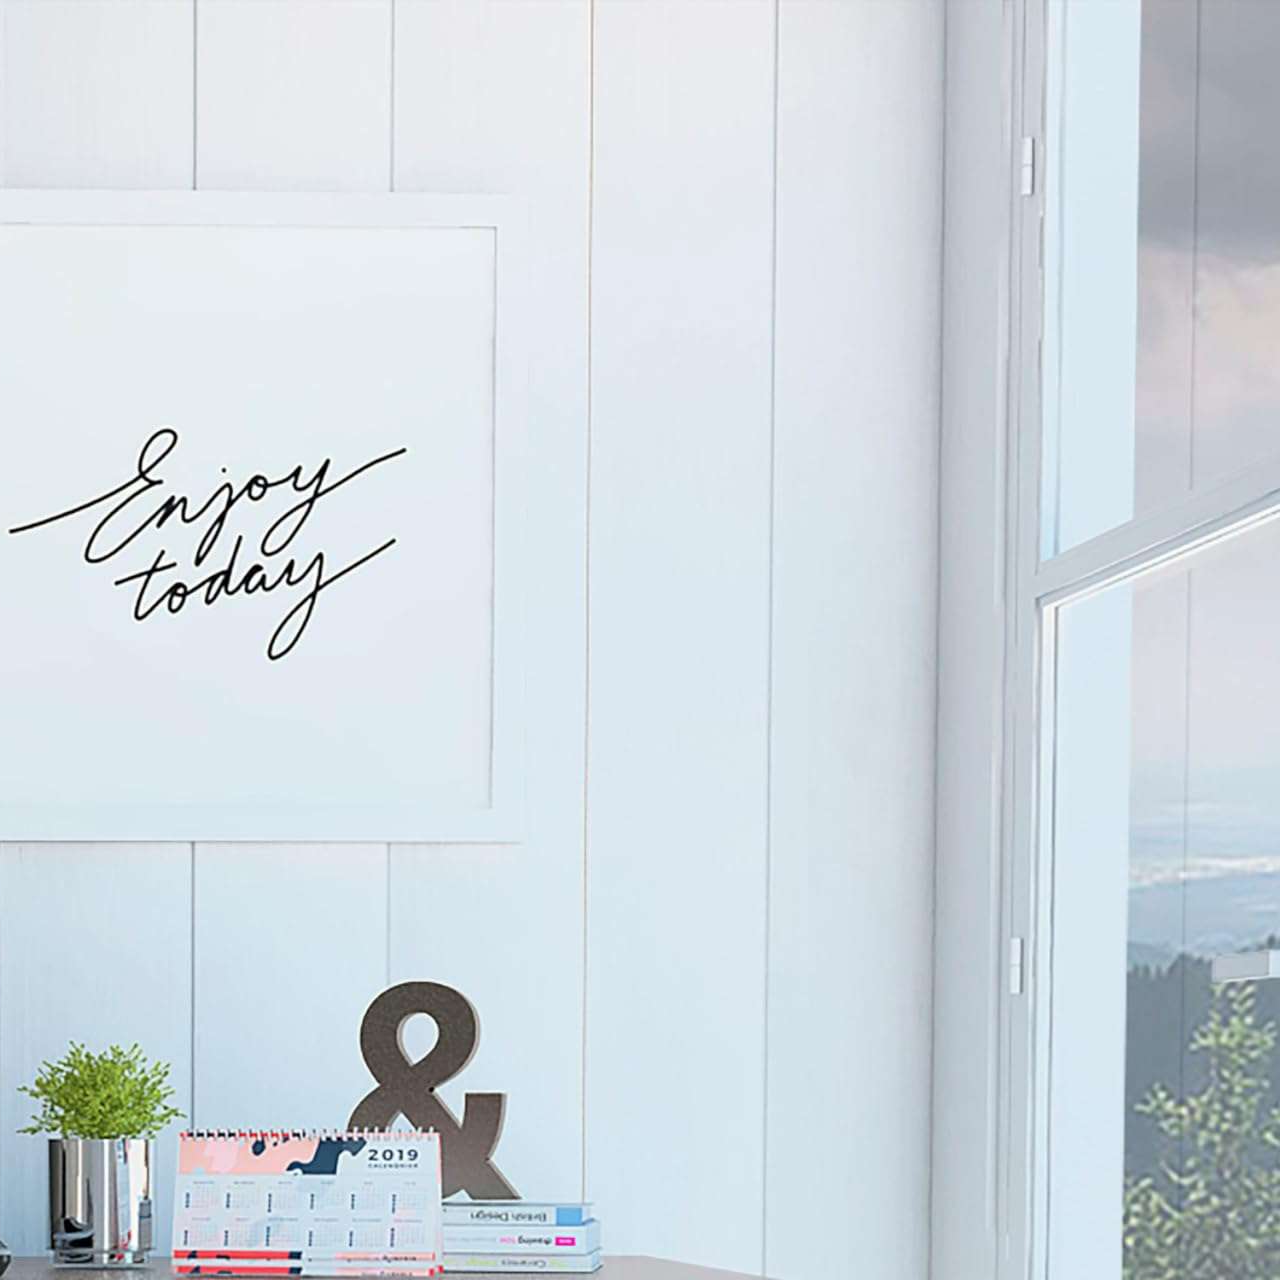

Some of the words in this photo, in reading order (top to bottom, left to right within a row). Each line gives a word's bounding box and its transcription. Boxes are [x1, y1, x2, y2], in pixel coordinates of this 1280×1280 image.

[9, 428, 407, 567] Enjoy
[114, 535, 397, 661] today
[367, 1149, 419, 1162] 2019
